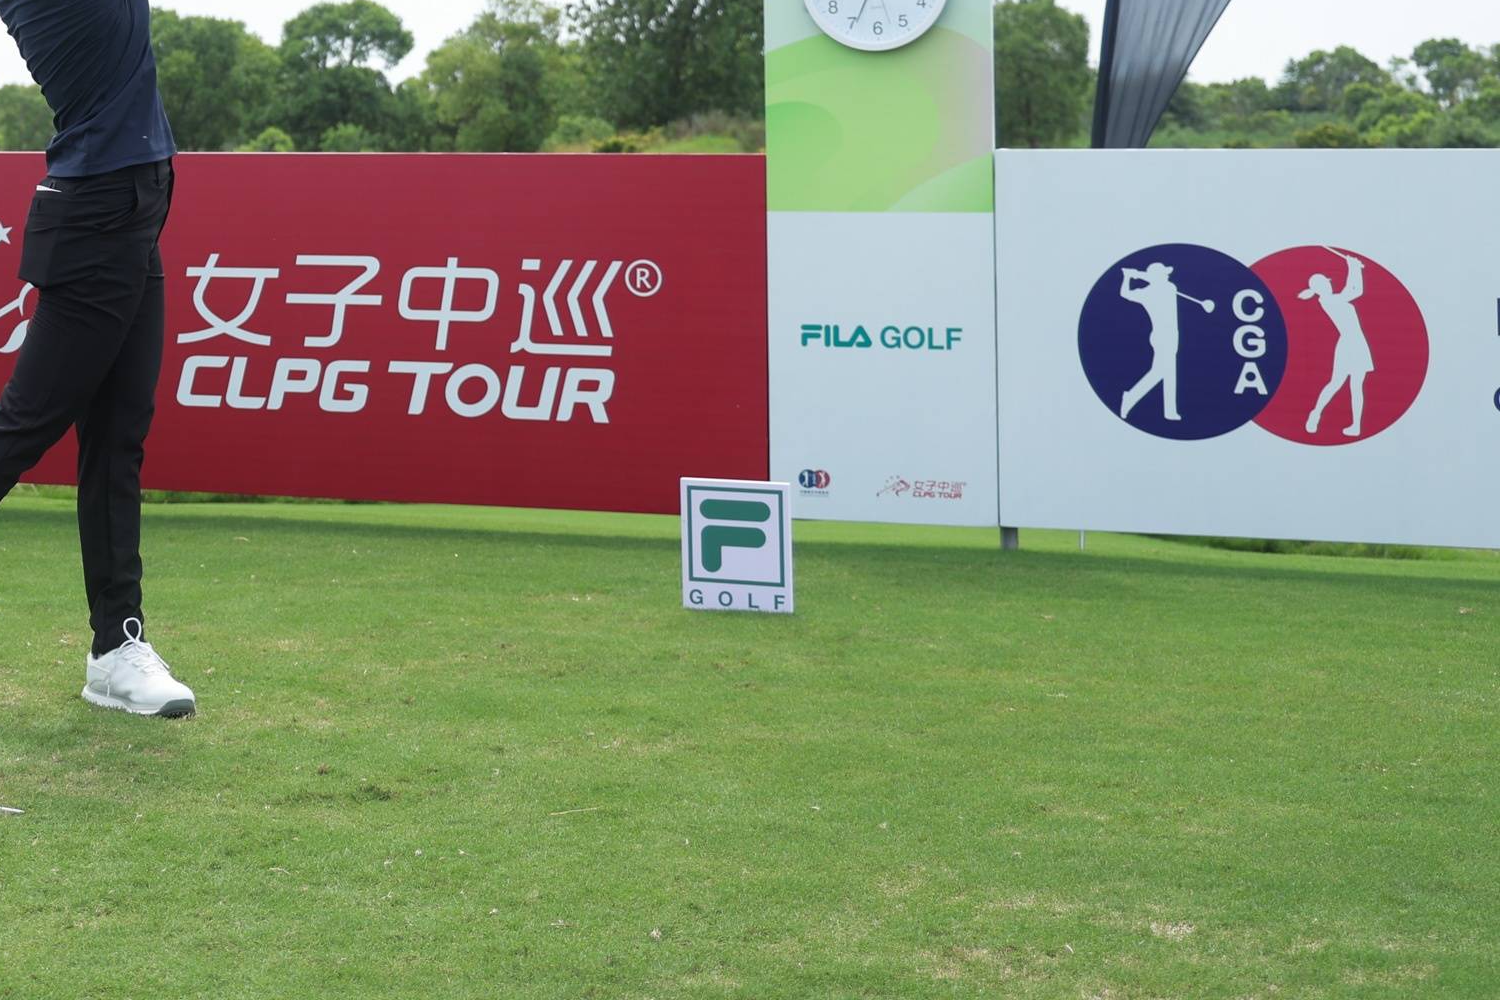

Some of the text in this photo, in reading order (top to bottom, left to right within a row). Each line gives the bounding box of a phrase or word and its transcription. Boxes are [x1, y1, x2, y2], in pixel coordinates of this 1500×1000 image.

[828, 0, 839, 14] 8
[846, 16, 858, 30] 7
[872, 21, 883, 36] 6
[898, 14, 908, 28] 5
[801, 324, 963, 350] FILA GOLF
[1232, 288, 1268, 395] CGA
[177, 355, 615, 424] CLPG TOUR
[689, 589, 785, 611] GOLF
